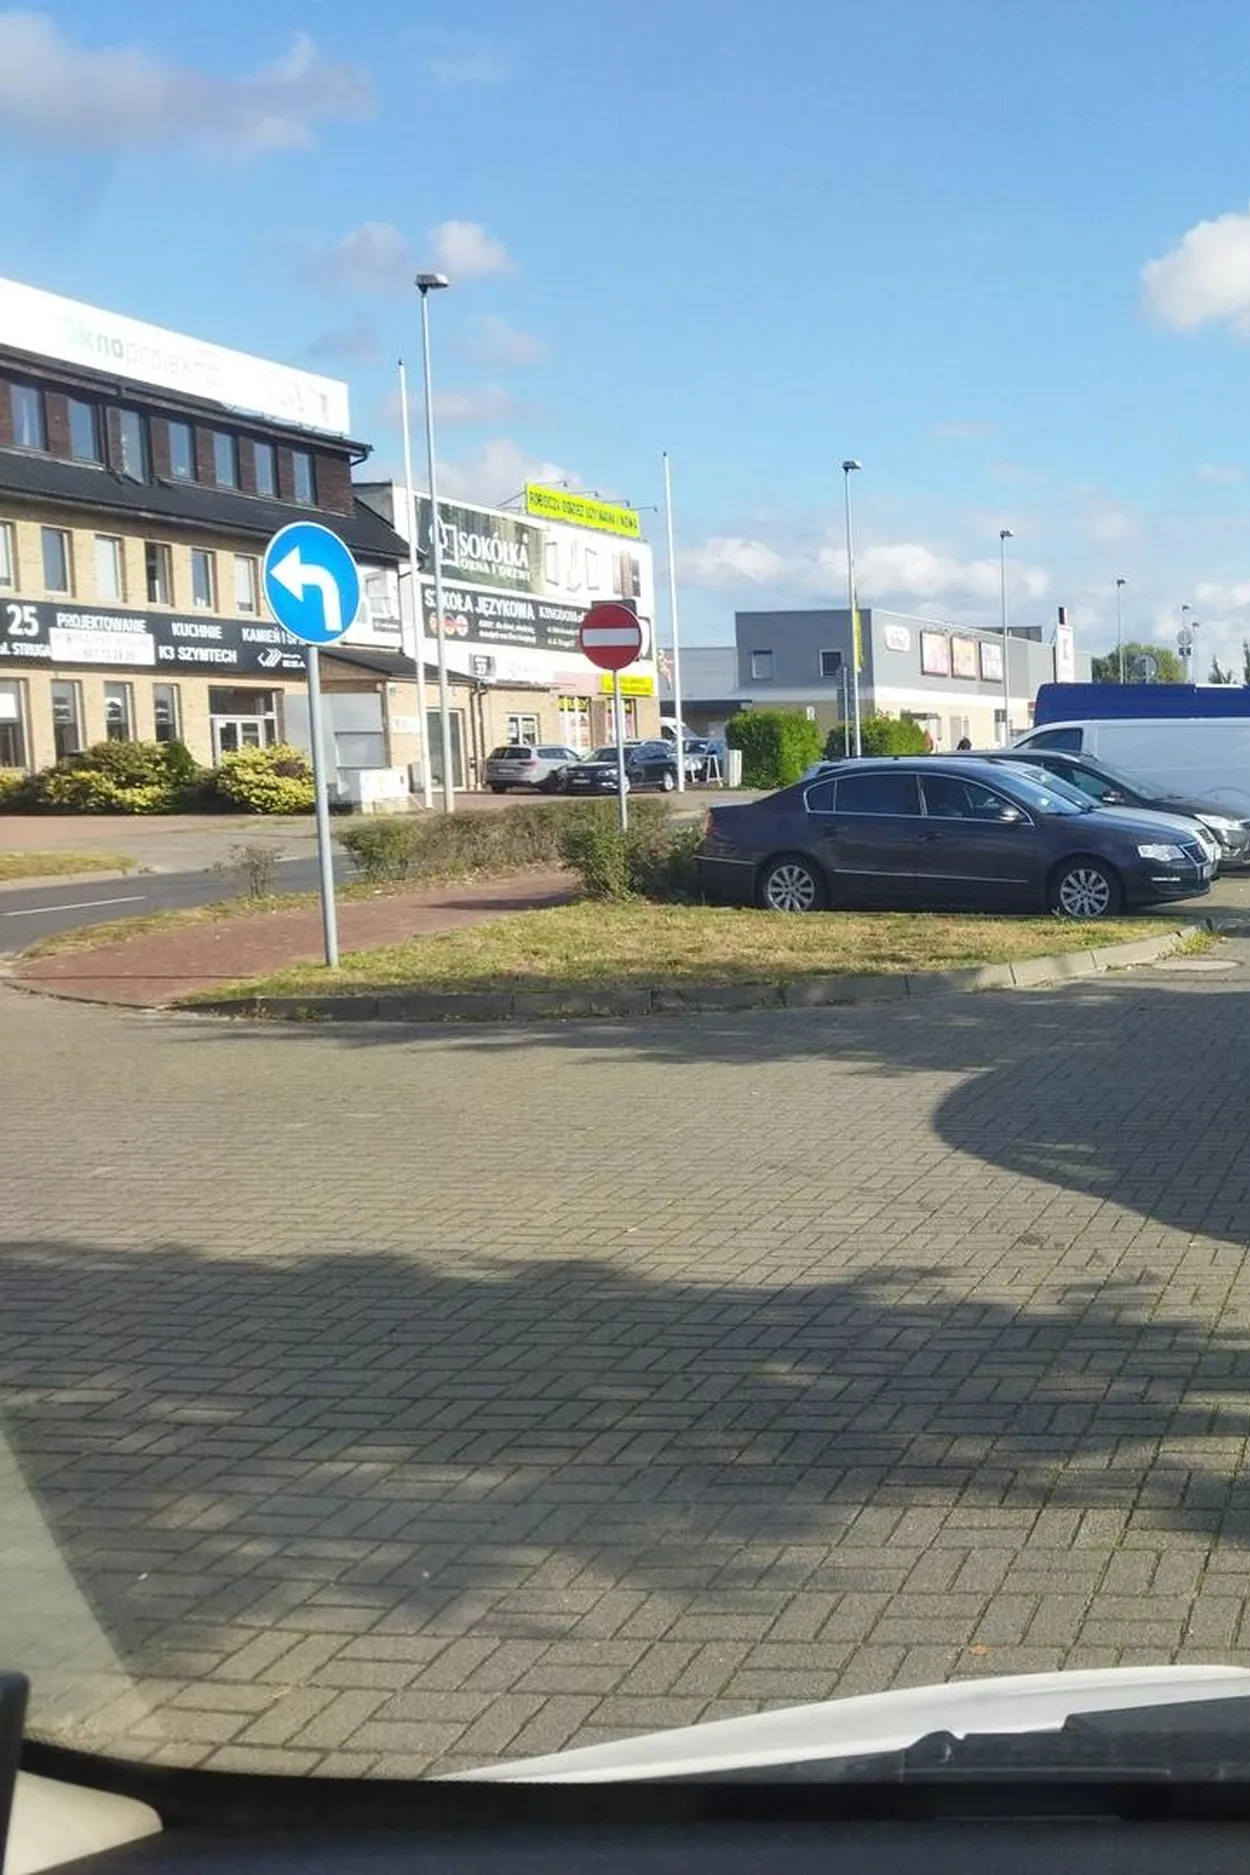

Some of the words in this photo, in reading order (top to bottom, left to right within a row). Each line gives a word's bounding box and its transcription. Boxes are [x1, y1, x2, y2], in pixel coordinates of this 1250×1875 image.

[475, 596, 536, 622] JĘZYKOWA
[6, 603, 40, 638] 25
[55, 612, 148, 634] PROJEKTOWANIE
[171, 621, 224, 640] KUCHNIE
[158, 644, 175, 660] K3
[177, 645, 237, 664] SZYMTECH
